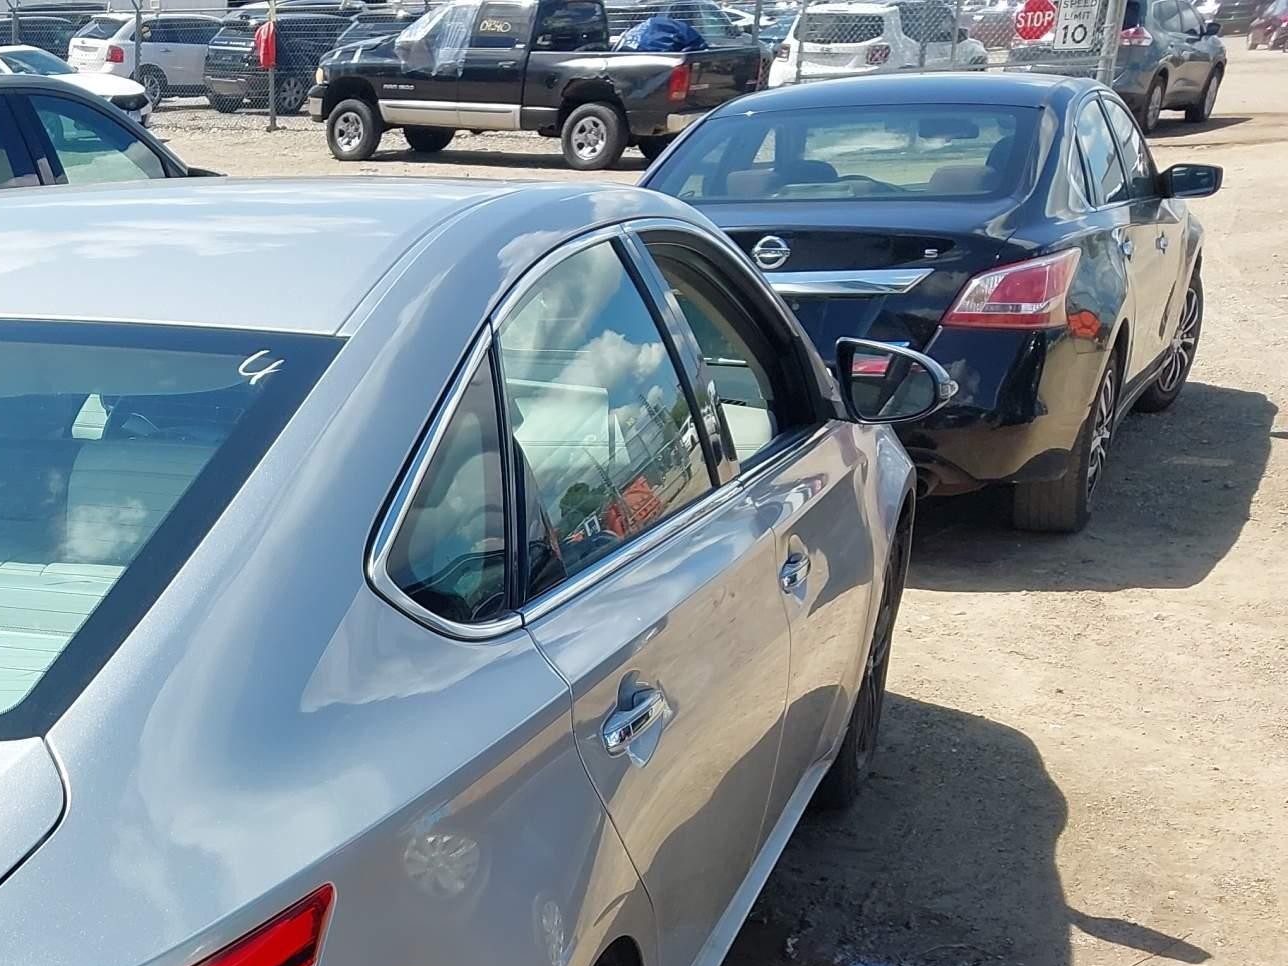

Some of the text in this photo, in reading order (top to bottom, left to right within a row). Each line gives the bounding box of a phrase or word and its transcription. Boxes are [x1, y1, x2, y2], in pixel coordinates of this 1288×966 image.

[1017, 11, 1053, 28] STOP
[1064, 11, 1091, 20] LIMIT
[1062, 24, 1087, 44] 10
[924, 249, 938, 258] S
